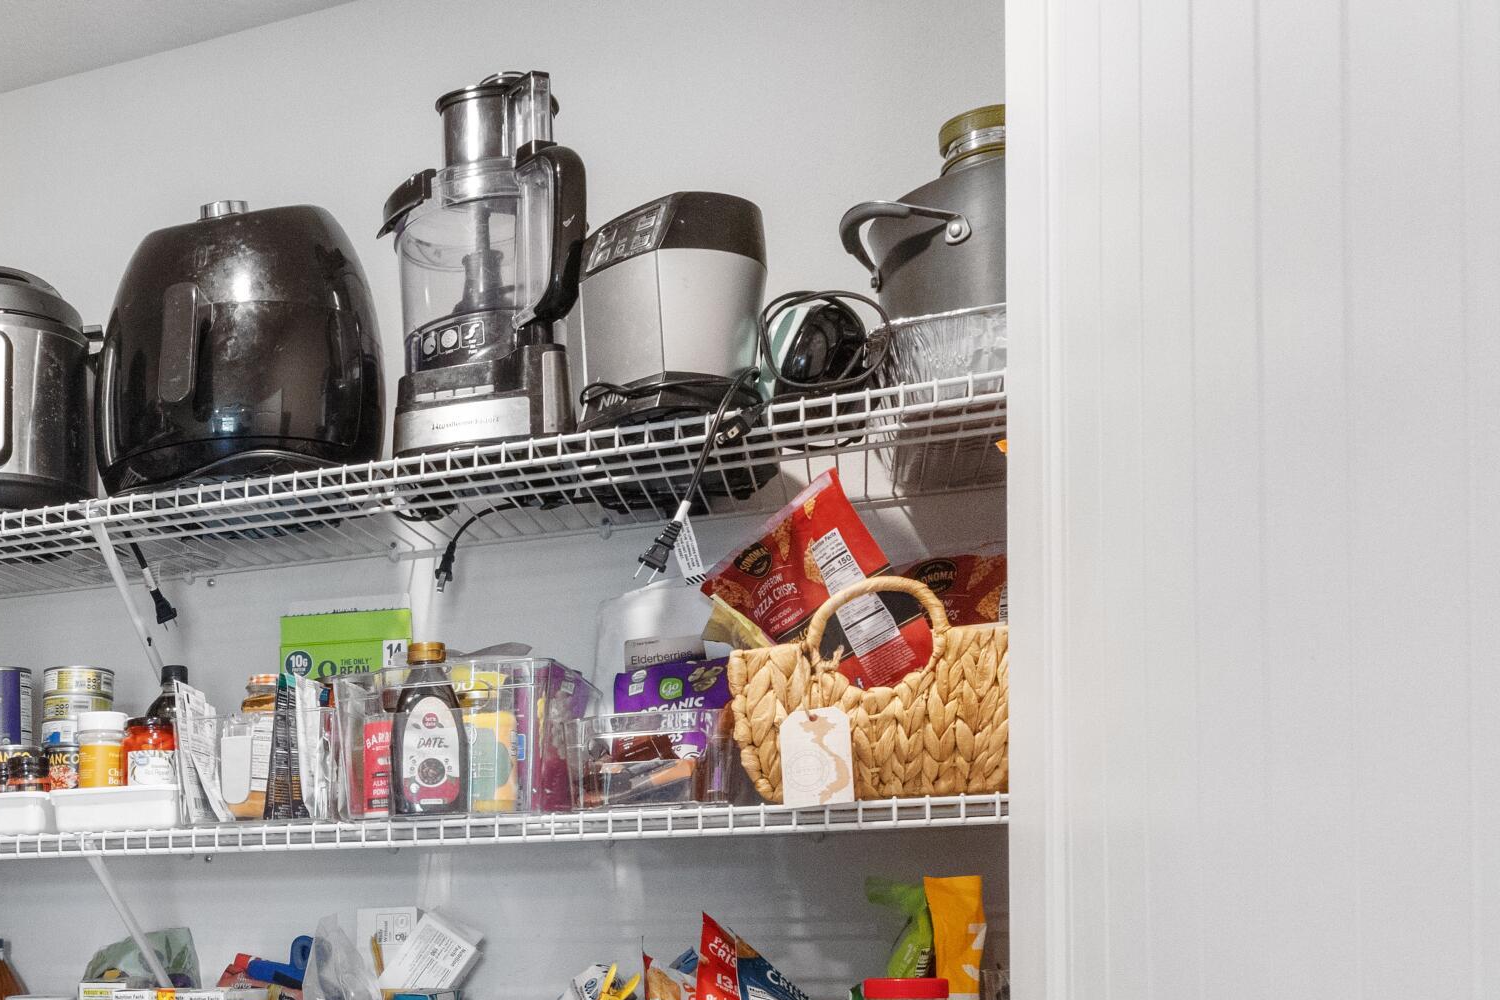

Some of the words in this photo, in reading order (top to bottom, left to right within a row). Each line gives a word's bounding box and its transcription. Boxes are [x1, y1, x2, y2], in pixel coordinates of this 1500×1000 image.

[837, 554, 852, 567] 150
[921, 570, 955, 583] ONOMA
[773, 582, 799, 602] CRISPS
[708, 943, 737, 968] CRIS
